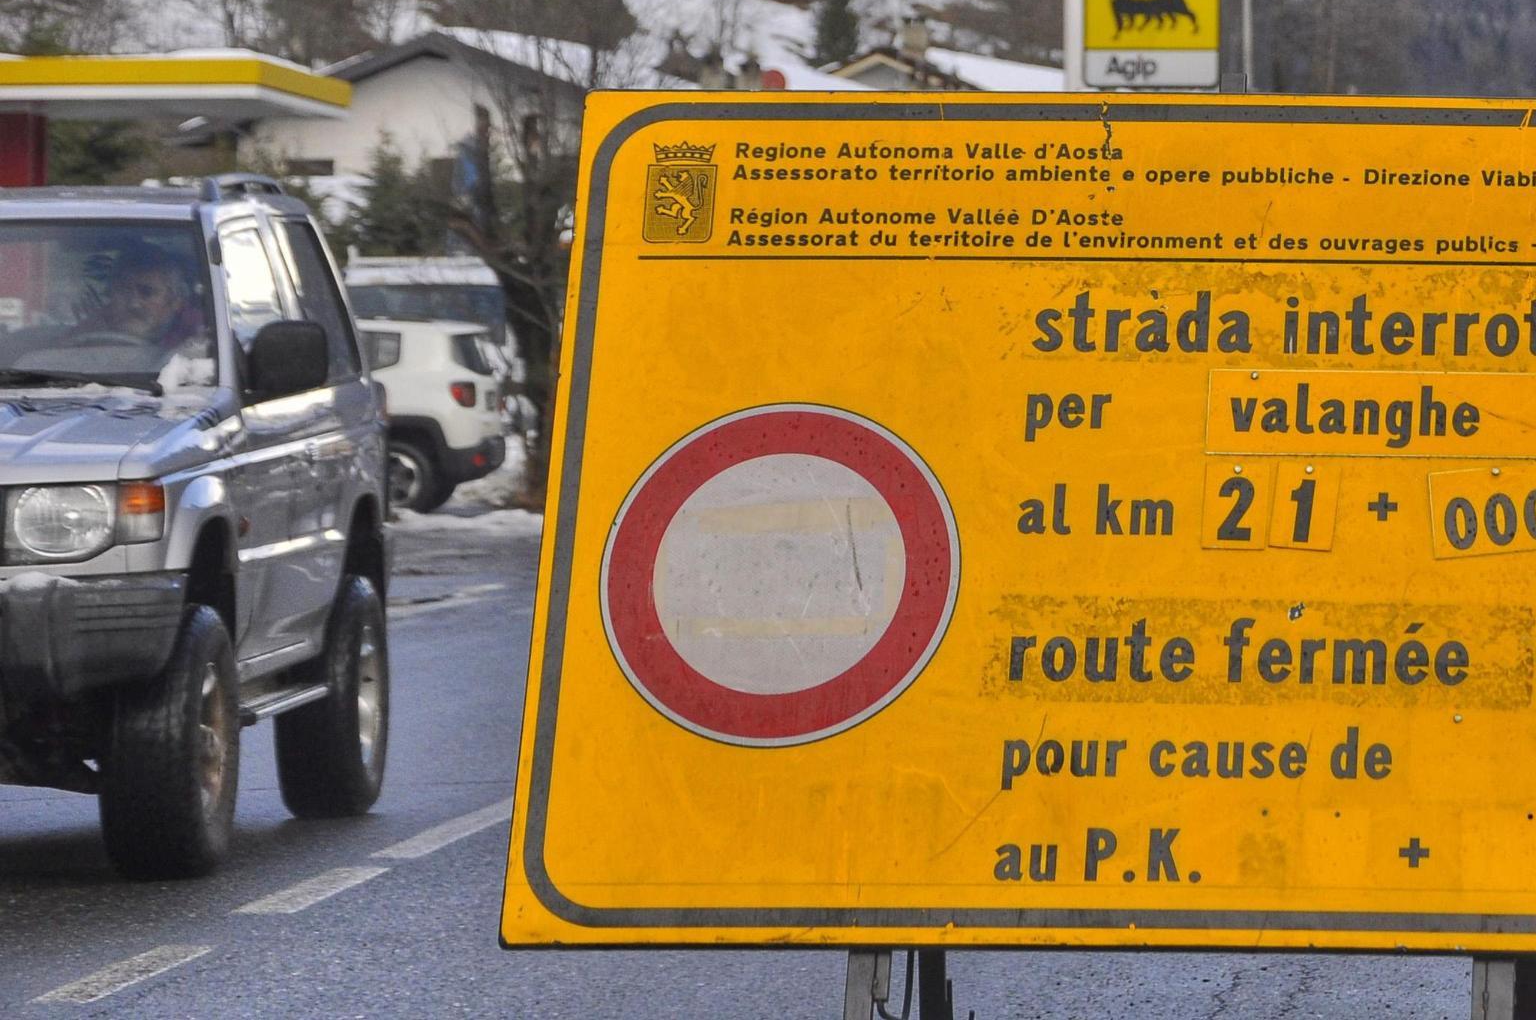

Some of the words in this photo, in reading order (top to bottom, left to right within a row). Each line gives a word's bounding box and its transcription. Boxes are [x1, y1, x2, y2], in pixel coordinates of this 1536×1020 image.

[1106, 56, 1158, 80] Agip
[733, 165, 877, 180] Assessorato
[889, 165, 994, 181] territorio
[1006, 166, 1110, 181] ambiente
[1123, 170, 1134, 181] e
[1146, 170, 1210, 185] opere
[1222, 167, 1333, 185] pubbliche
[1365, 169, 1469, 186] Direzione
[736, 143, 826, 161] Regione
[838, 143, 953, 158] Autonoma
[966, 144, 1022, 159] Valle
[1035, 142, 1122, 160] d'Aosta
[727, 230, 858, 246] Assessorat
[870, 231, 896, 246] du
[909, 231, 1014, 247] territoire
[1026, 231, 1052, 247] de
[1064, 232, 1222, 249] l'environment
[1234, 234, 1257, 249] et
[1269, 234, 1307, 250] des
[1320, 239, 1423, 254] ouvrages
[1437, 236, 1518, 254] publics
[731, 208, 807, 227] Région
[819, 209, 935, 224] Autonome
[1032, 209, 1123, 226] D'Aoste
[1034, 291, 1251, 352] strada
[1026, 394, 1111, 441] per
[1232, 384, 1479, 447] valanghe
[1018, 484, 1070, 534] al
[1097, 484, 1173, 534] km
[1009, 619, 1194, 682] route
[1225, 618, 1468, 685] fermée
[1002, 740, 1126, 789] pour
[1150, 741, 1306, 778] cause
[1331, 728, 1391, 778] de
[995, 845, 1057, 881] au
[1085, 829, 1200, 882] P.K.
